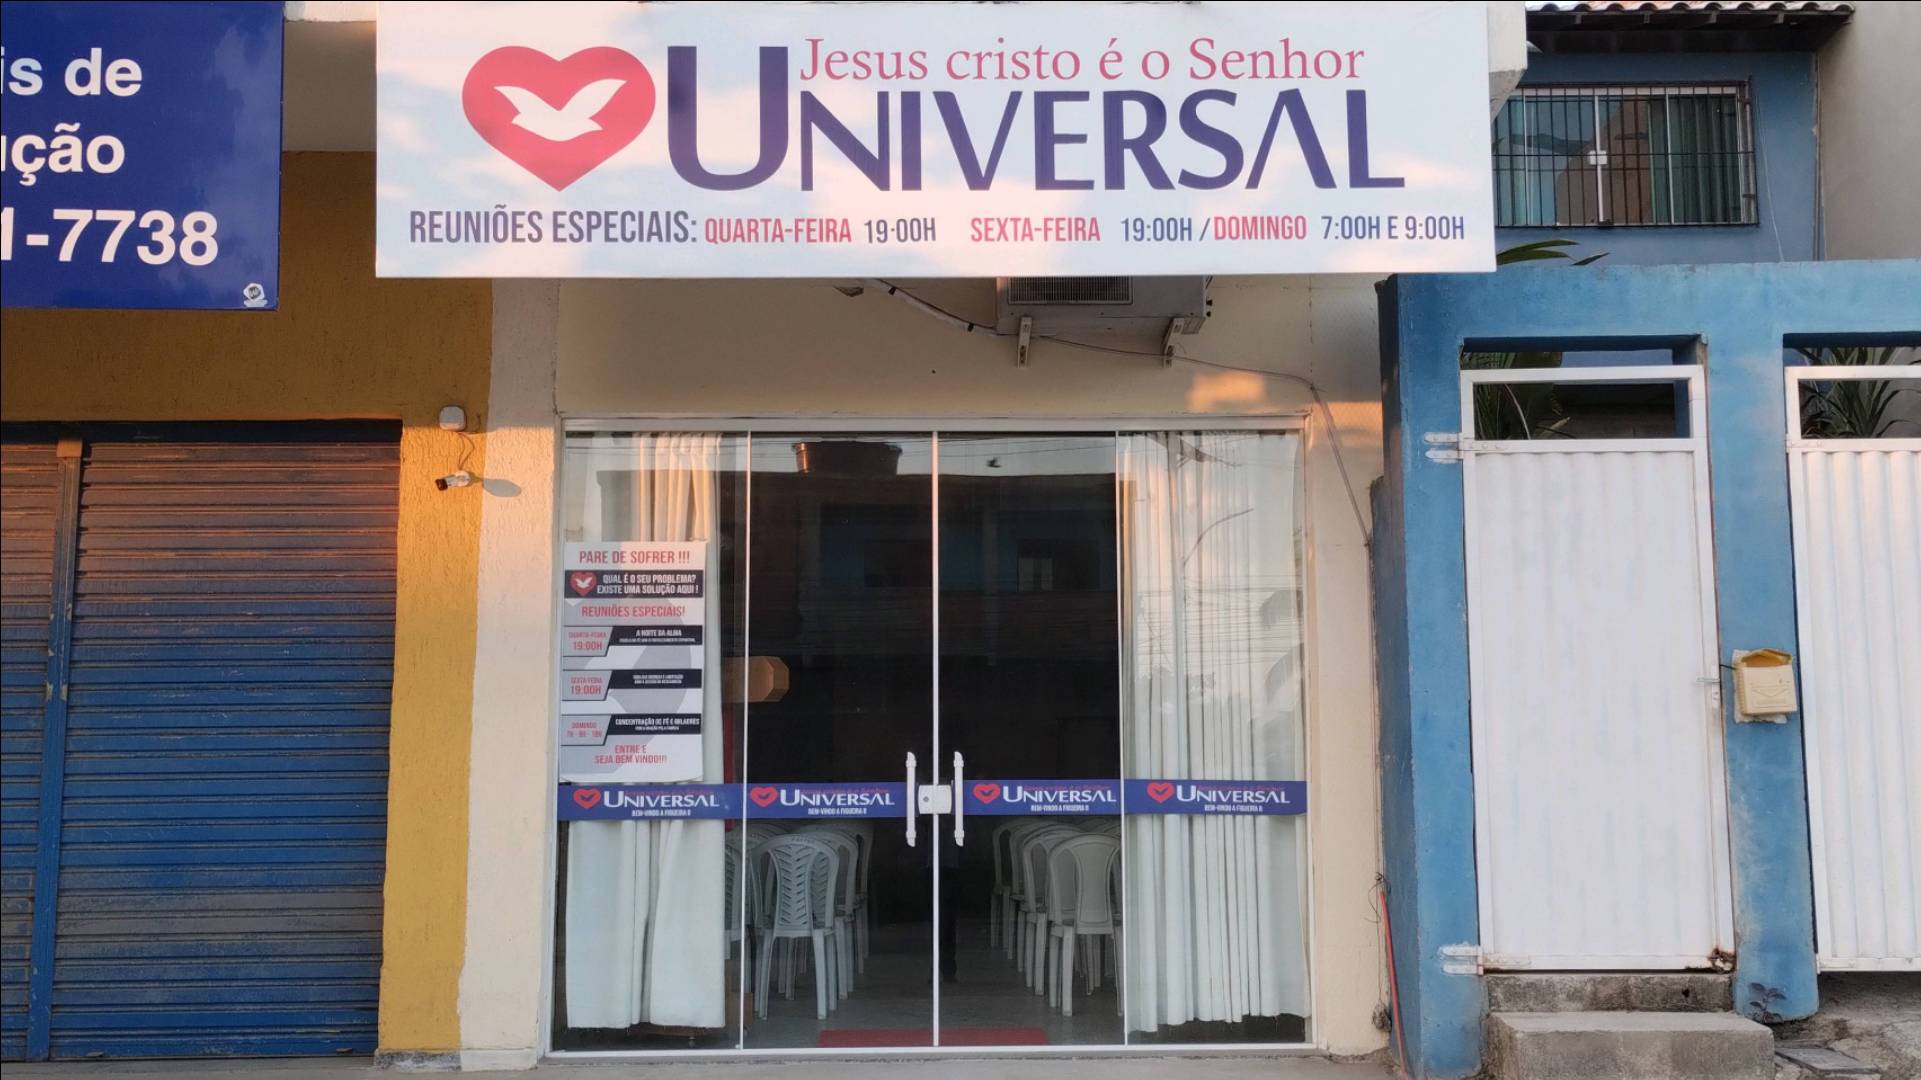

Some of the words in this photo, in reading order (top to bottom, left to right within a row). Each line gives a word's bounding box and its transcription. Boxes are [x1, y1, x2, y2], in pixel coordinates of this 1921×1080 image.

[800, 37, 928, 81] Jesus
[946, 36, 1080, 81] cristo
[1099, 37, 1123, 80] é
[1141, 48, 1170, 80] o
[1189, 37, 1365, 80] Senhor
[64, 47, 143, 97] de
[667, 45, 1405, 192] UNIVERSAL
[409, 203, 543, 244] REUNIÕES
[552, 209, 698, 244] ESPECIAIS:
[704, 217, 853, 244] QUARTA-FEIRA
[970, 217, 1101, 243] SEXTA-FEIRA
[1120, 217, 1193, 242] 19:00H
[1321, 215, 1380, 241] 7:00H
[1387, 215, 1399, 240] E
[1405, 215, 1465, 241] 9:00H
[579, 550, 609, 564] PARE
[612, 550, 627, 564] DE
[630, 550, 675, 564] SOFRER
[602, 574, 622, 584] QUAL
[623, 572, 629, 583] É
[630, 574, 636, 583] O
[636, 574, 651, 583] SEU
[652, 574, 697, 584] PROBLEMA?
[597, 585, 623, 594] EXISTE
[624, 585, 640, 594] UMA
[641, 583, 676, 595] SOLUÇÃO
[676, 585, 695, 594] AQUI
[581, 603, 630, 617] REUNIÕES
[632, 605, 686, 617] ESPECIAIS!
[573, 641, 603, 651] 19:00H
[571, 685, 602, 695] 19:00H
[614, 745, 641, 754] ENTRE
[594, 755, 614, 764] SEJA
[615, 755, 633, 764] BEM
[603, 790, 720, 808] UNIVERSAL
[780, 789, 895, 806] UNIVERSAL
[1003, 786, 1117, 802] UNIVERSAL
[1176, 785, 1290, 804] UNIVERSAL
